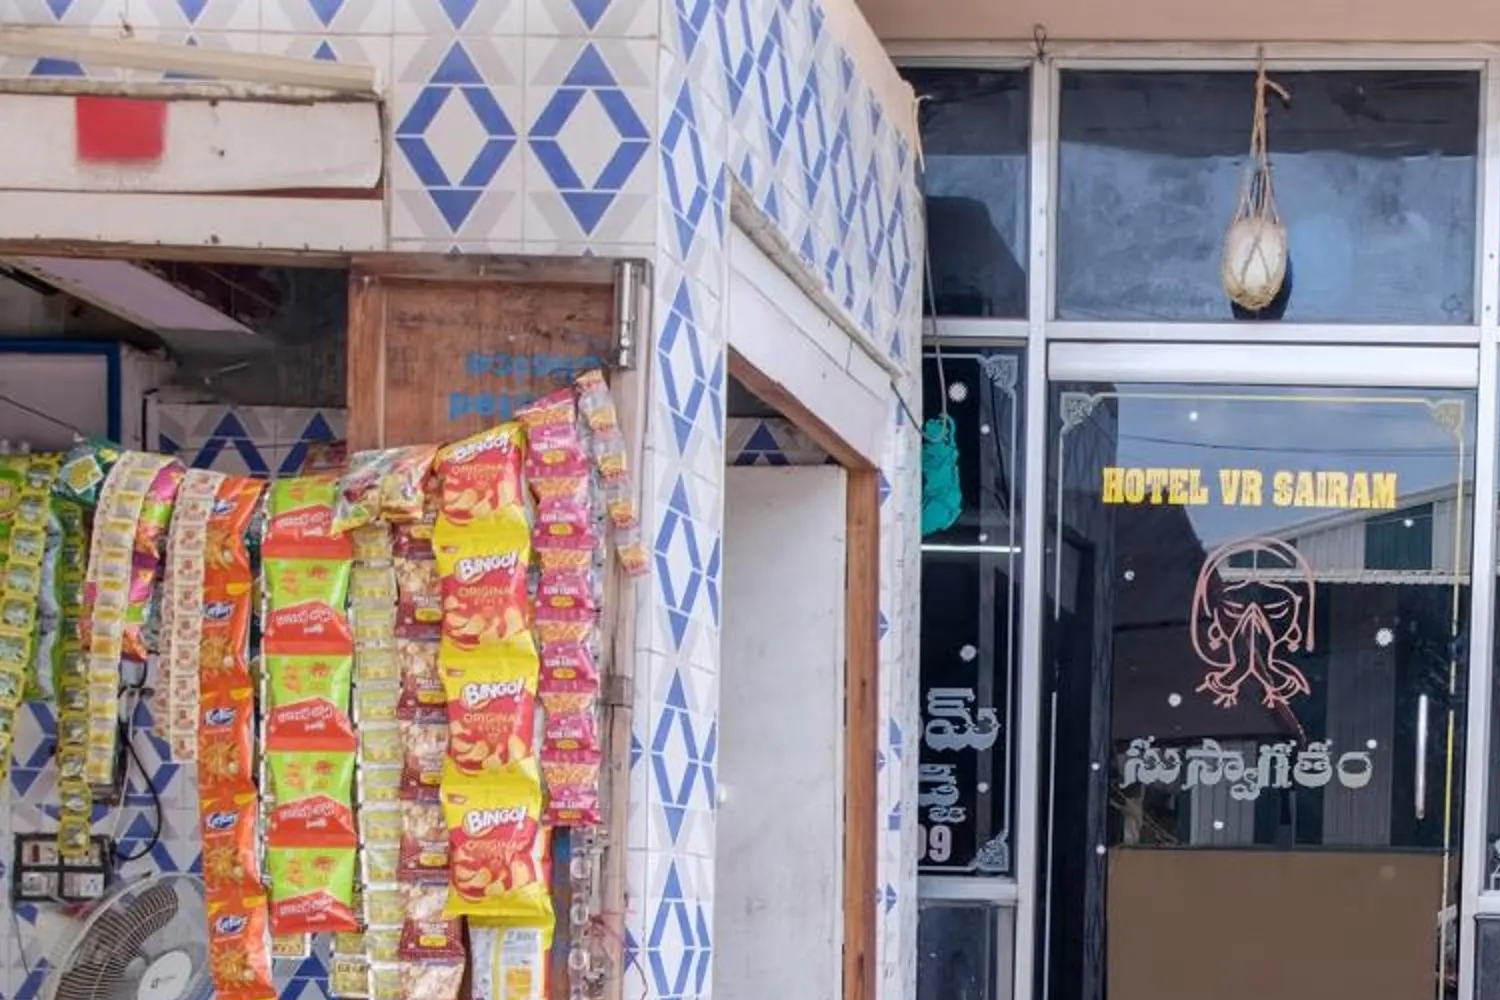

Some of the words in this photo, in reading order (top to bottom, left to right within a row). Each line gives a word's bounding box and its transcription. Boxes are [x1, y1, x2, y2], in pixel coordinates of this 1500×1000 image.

[1102, 467, 1209, 505] HOTEL
[1219, 468, 1263, 506] VR
[1272, 471, 1398, 509] SAIRAM
[457, 551, 518, 582] BINGO!
[464, 678, 525, 705] BINGO!
[464, 806, 527, 834] BINGO!
